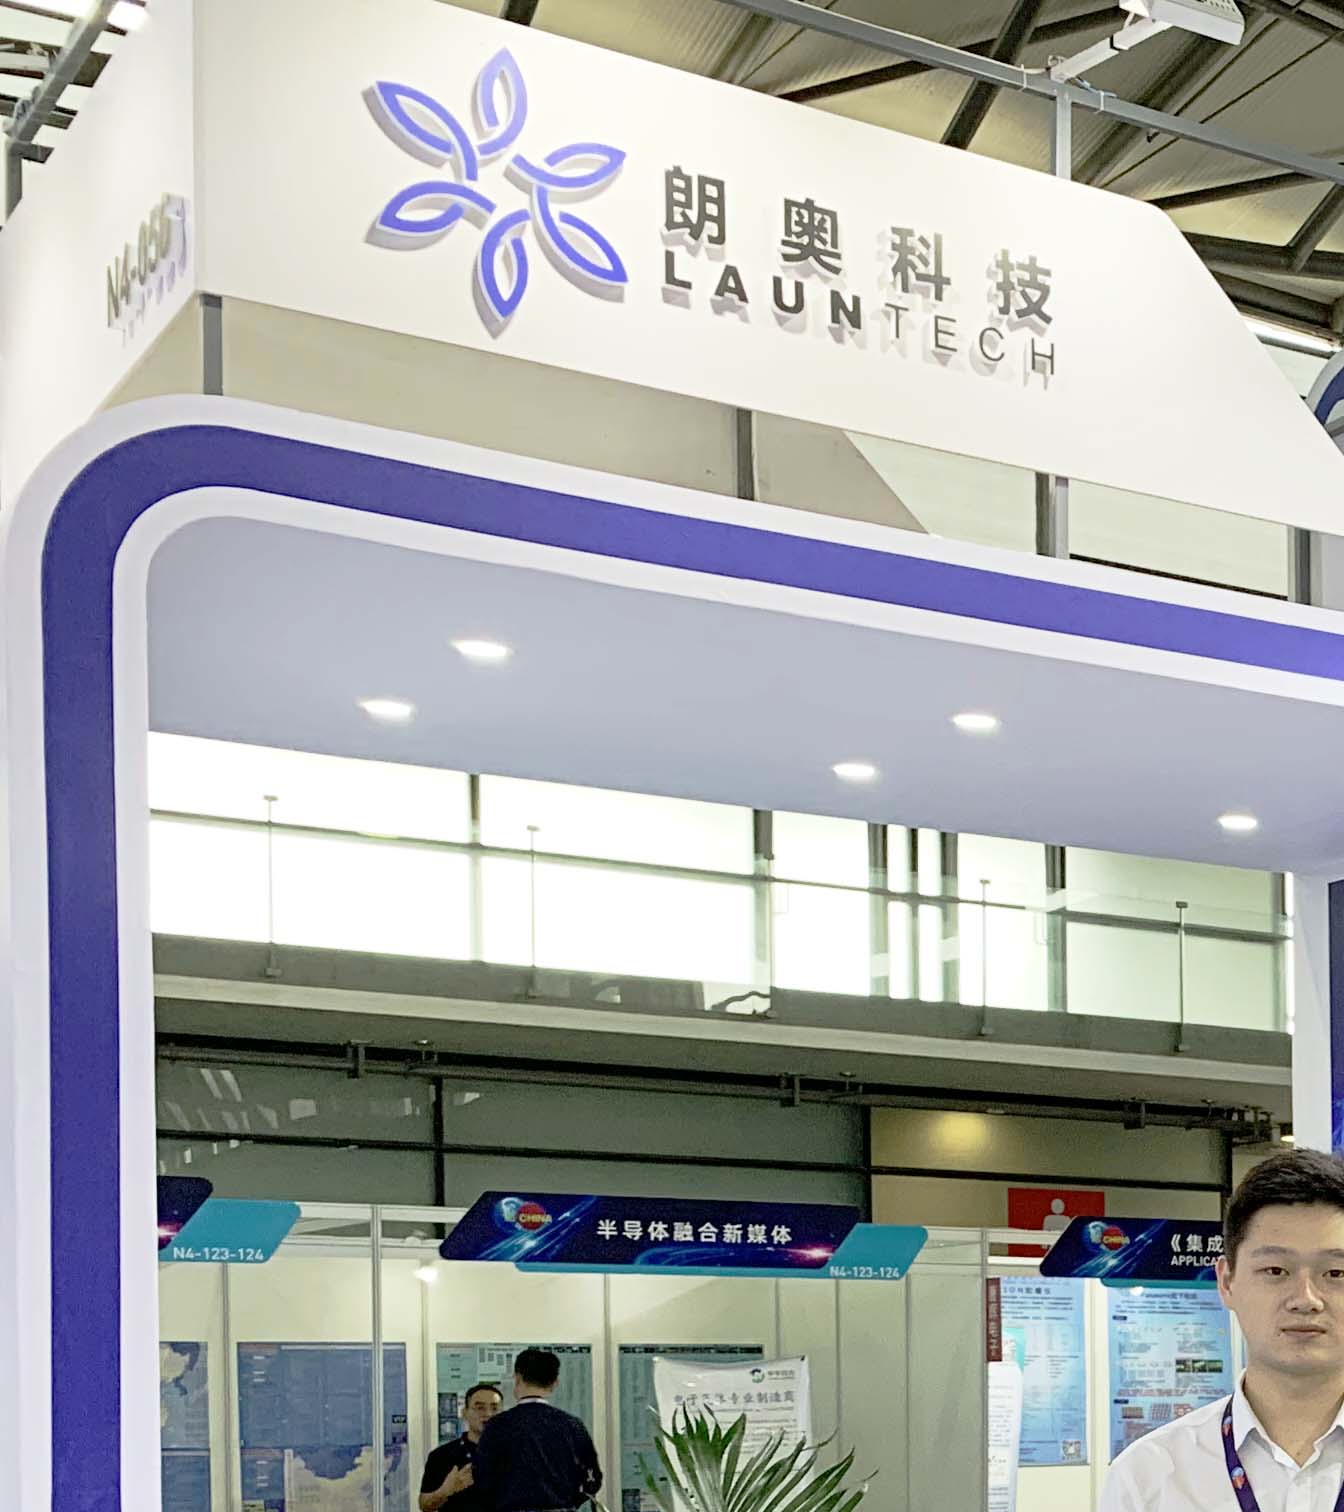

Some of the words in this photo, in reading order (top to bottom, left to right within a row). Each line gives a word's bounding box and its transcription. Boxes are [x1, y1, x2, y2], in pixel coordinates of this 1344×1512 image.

[664, 165, 1052, 324] 朗奥科技
[665, 250, 1055, 375] LAUNTECH
[597, 1219, 793, 1245] 半导体融合新媒体
[173, 1247, 264, 1261] N4-123-124
[830, 1265, 900, 1278] N4-123-124
